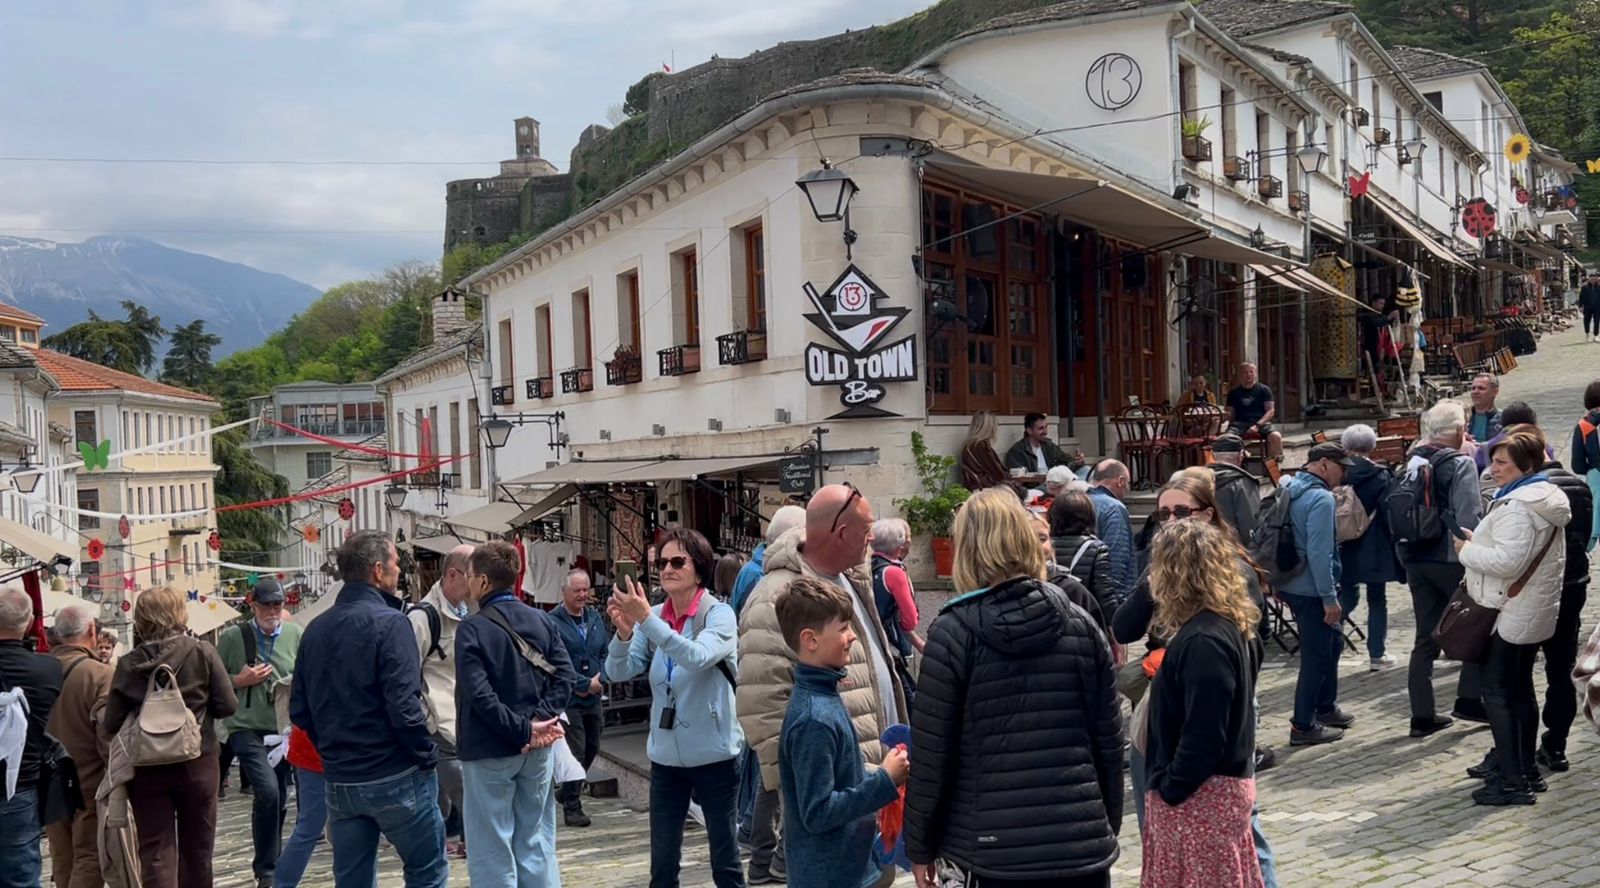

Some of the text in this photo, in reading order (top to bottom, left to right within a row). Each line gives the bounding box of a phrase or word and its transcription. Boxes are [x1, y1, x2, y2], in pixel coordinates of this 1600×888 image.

[1091, 56, 1133, 109] 13
[844, 286, 861, 306] 13
[808, 339, 914, 382] OLD TOWN
[845, 380, 882, 403] Bar
